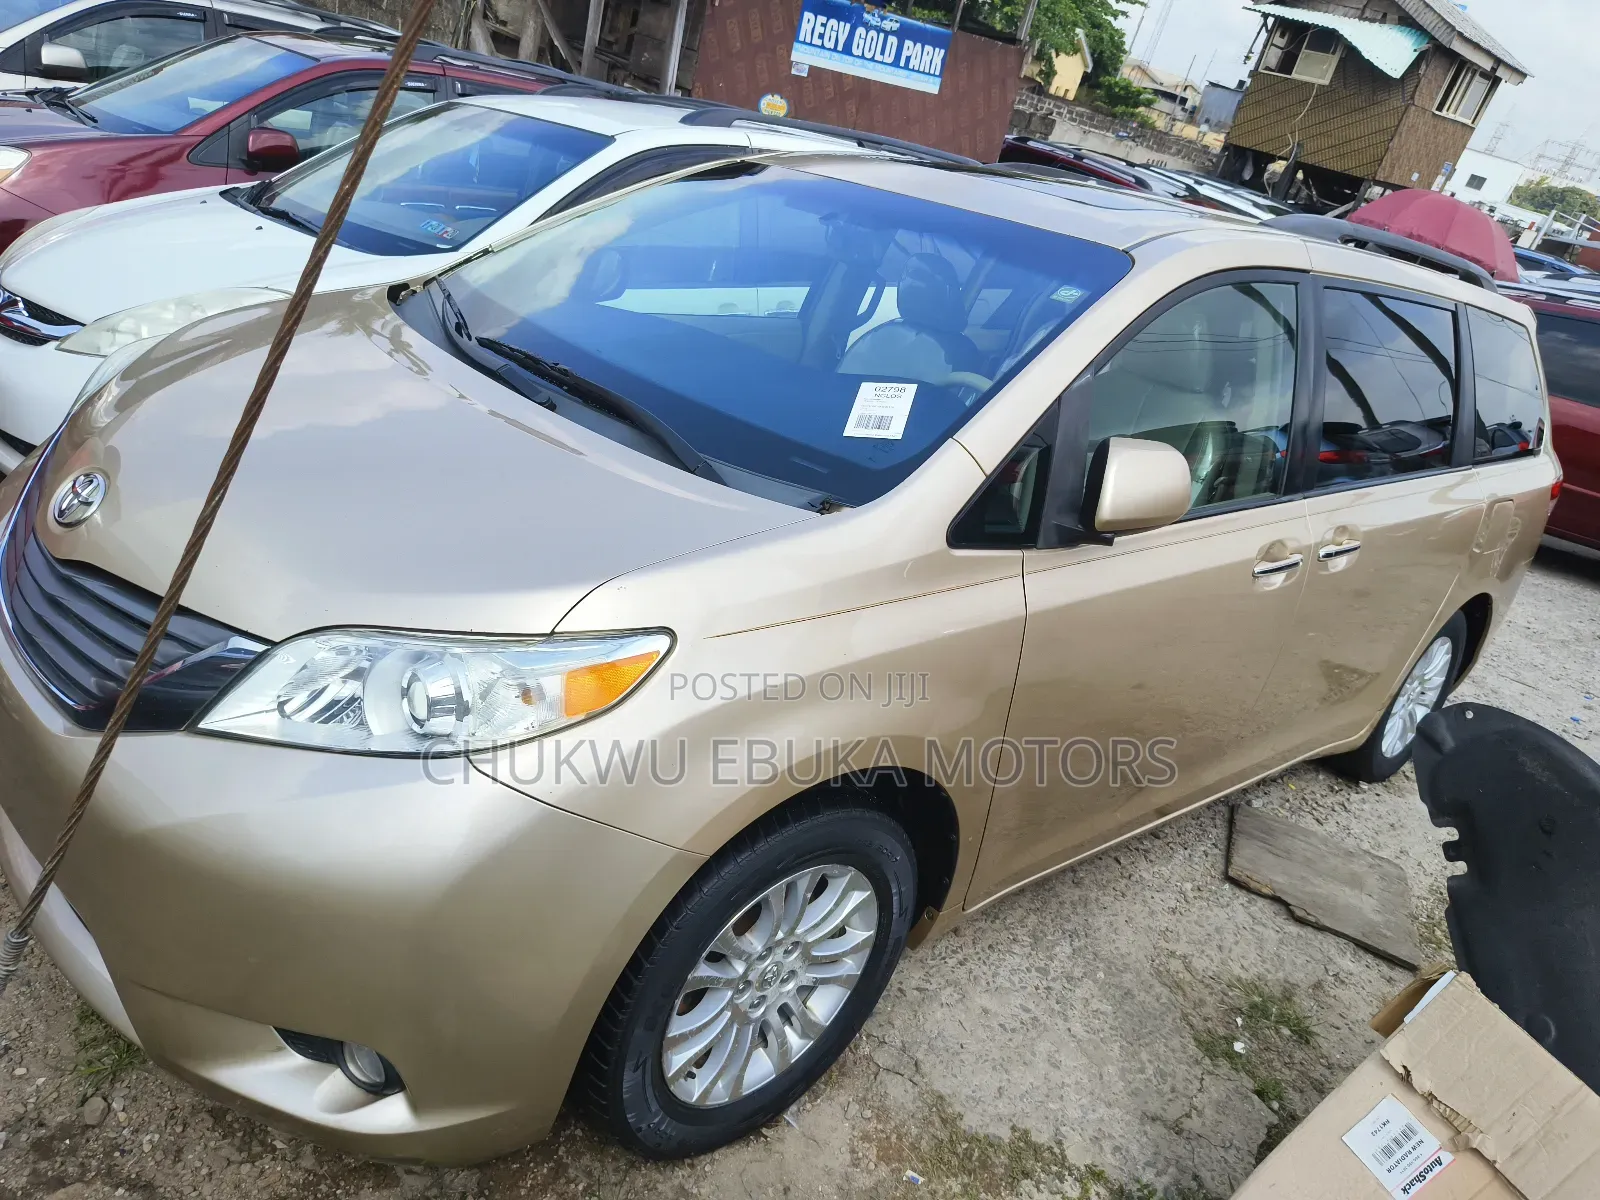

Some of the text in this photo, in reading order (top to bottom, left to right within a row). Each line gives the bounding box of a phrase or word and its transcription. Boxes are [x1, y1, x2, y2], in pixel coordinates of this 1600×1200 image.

[799, 11, 945, 76] REGY GOLD PARK
[1370, 1119, 1390, 1137] RK1742
[1411, 1139, 1425, 1152] NEW
[1386, 1150, 1413, 1174] RADIATOR
[1401, 1155, 1443, 1195] AutoShack
